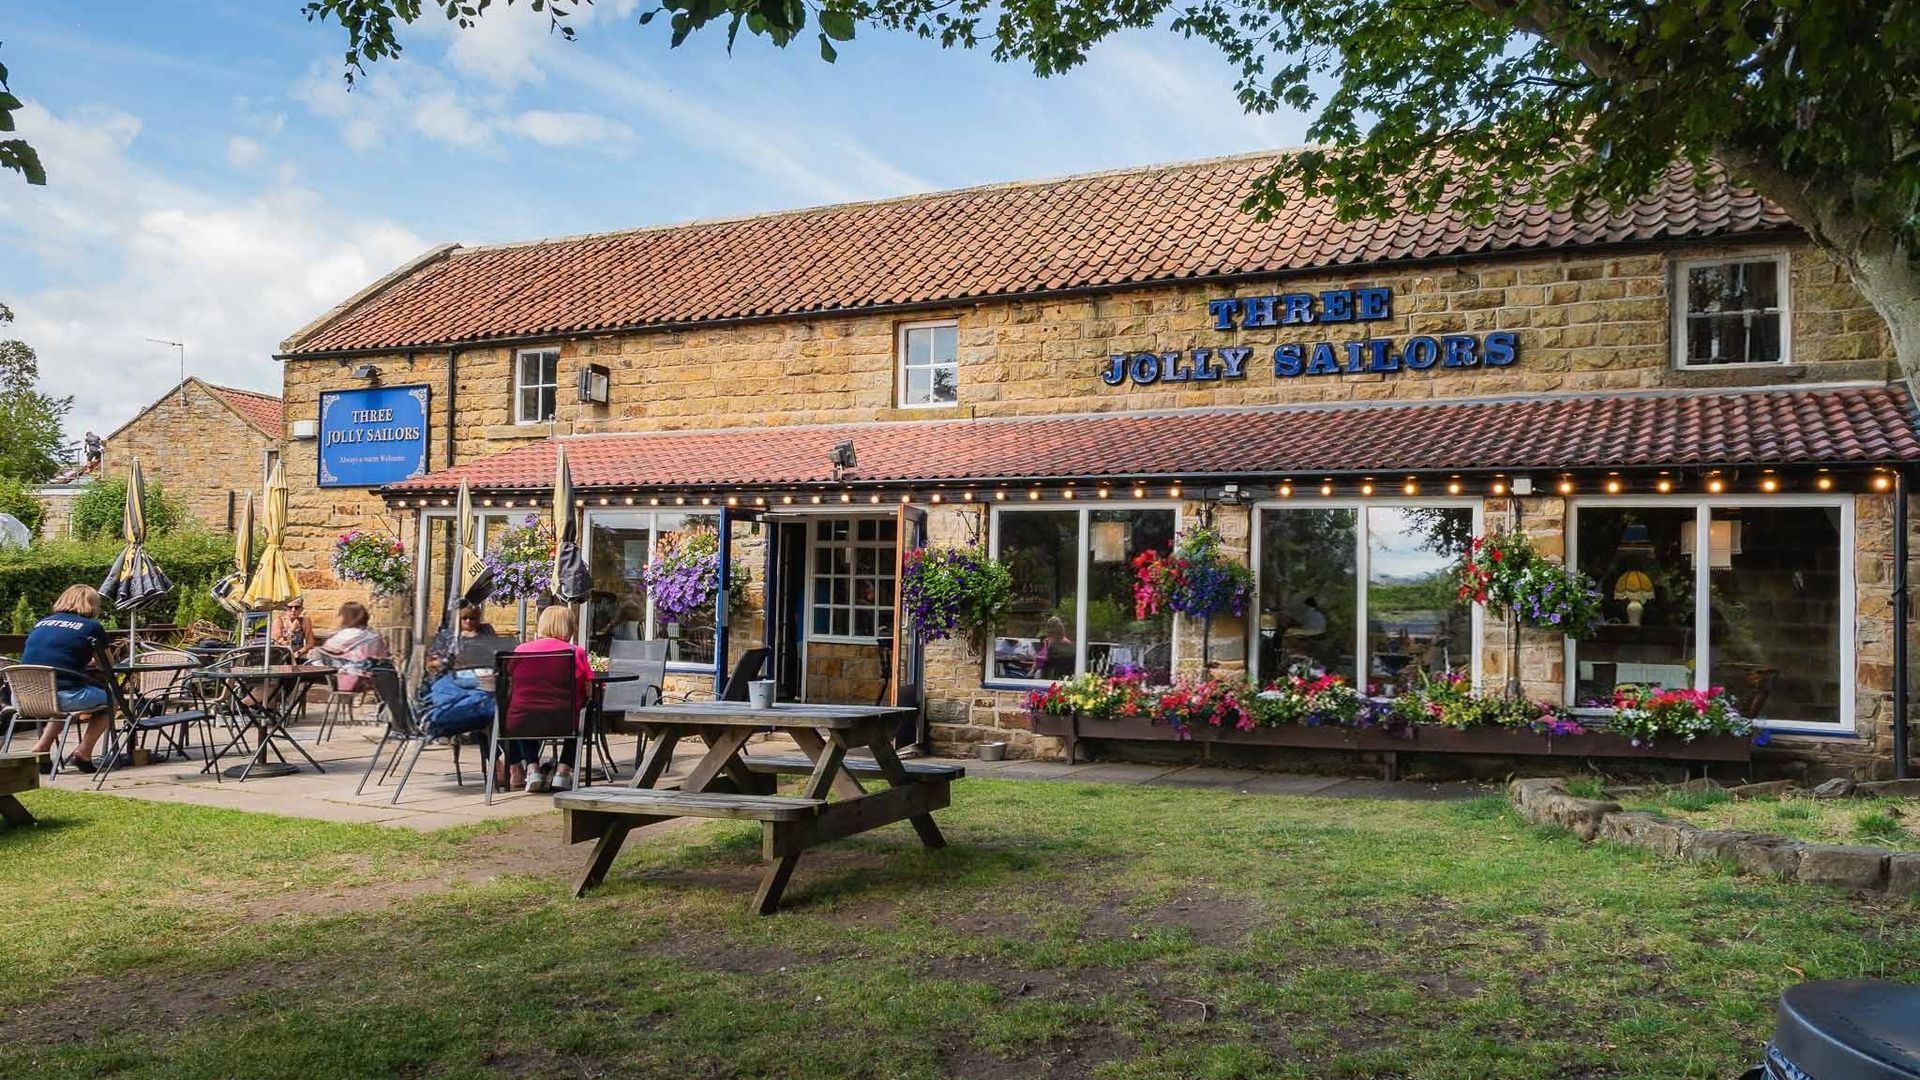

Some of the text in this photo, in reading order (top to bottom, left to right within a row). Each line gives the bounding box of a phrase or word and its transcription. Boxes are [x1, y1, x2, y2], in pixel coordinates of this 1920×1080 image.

[1208, 286, 1391, 331] THREE
[1102, 331, 1520, 386] JOLLY SAILORS
[352, 409, 393, 423] THREE
[326, 427, 420, 446] JOLLY SAILORS
